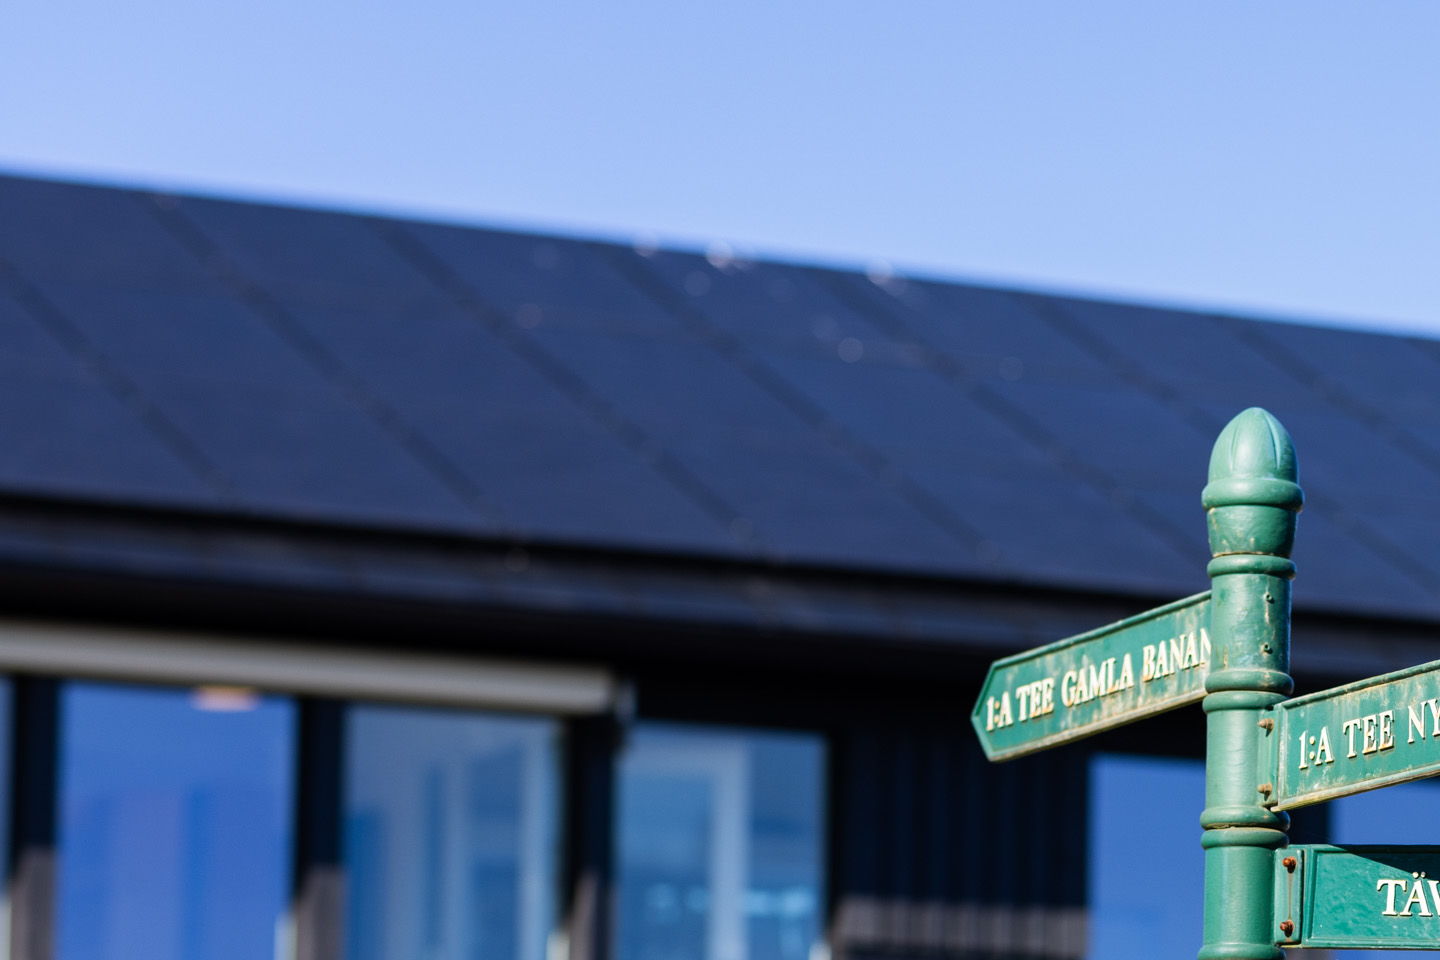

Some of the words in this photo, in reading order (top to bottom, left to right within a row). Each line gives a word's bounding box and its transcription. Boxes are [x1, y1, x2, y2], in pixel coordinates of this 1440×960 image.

[986, 691, 1014, 732] 1:A
[1016, 677, 1055, 722] TEE
[1061, 653, 1135, 708] GAMLA
[1299, 726, 1335, 770] 1:A
[1343, 710, 1395, 758] TEE
